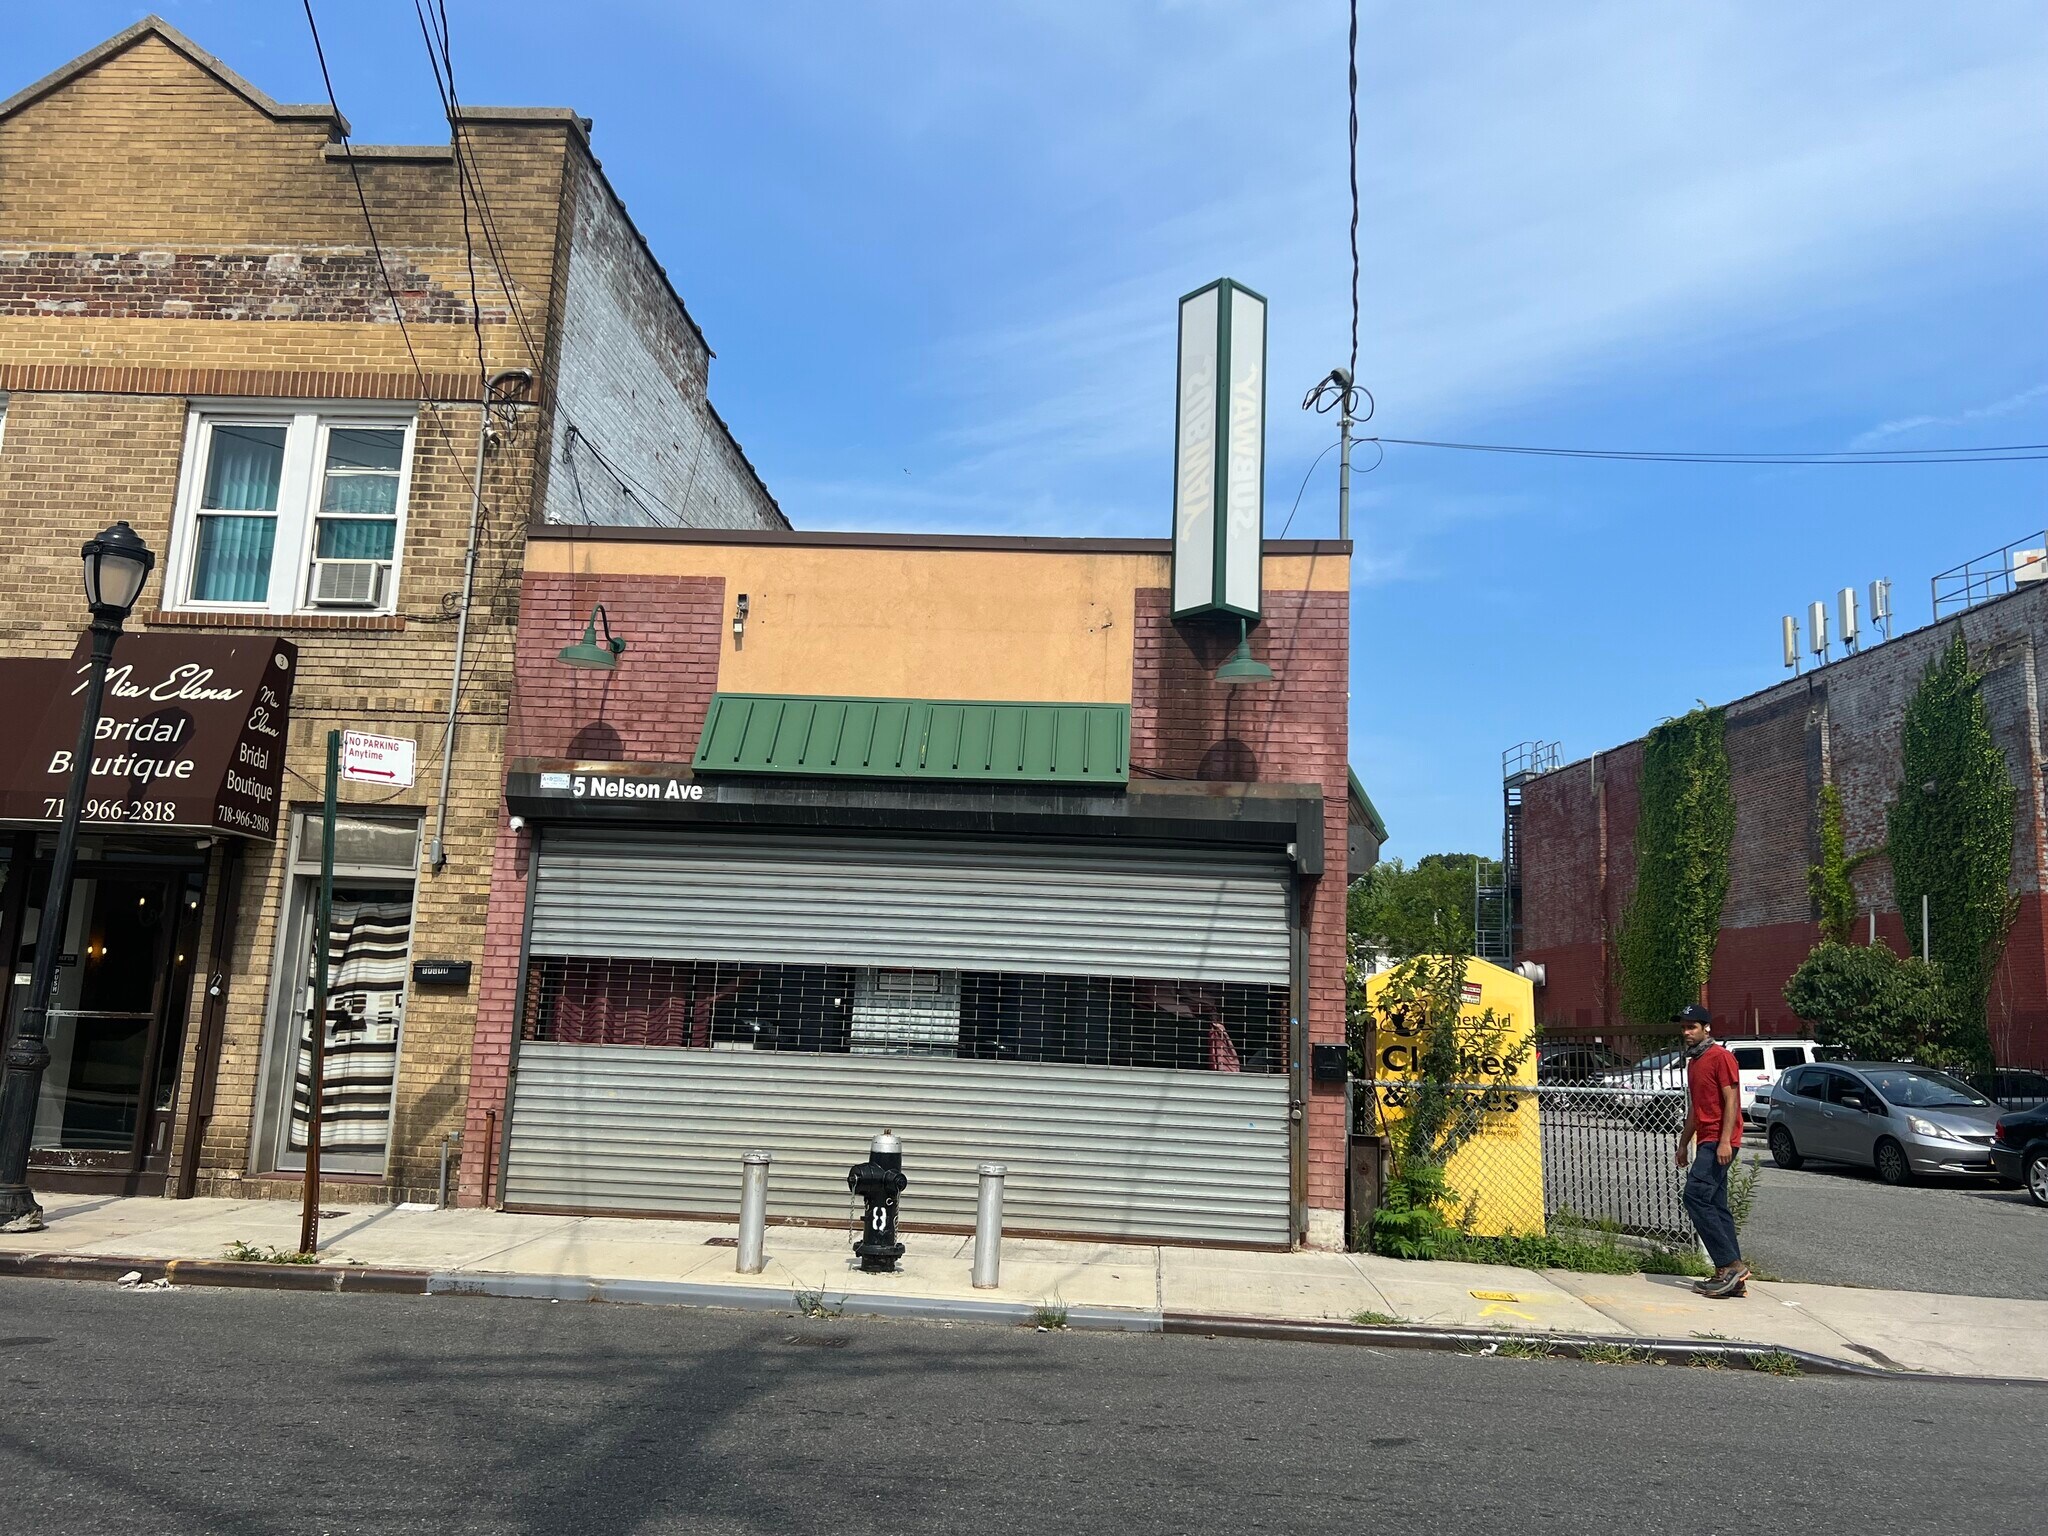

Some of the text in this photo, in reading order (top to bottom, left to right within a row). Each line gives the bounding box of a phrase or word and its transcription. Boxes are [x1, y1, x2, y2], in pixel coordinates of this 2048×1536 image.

[279, 656, 285, 667] 3
[150, 663, 243, 701] Elena
[94, 717, 186, 743] Bridal
[248, 706, 280, 738] Elena
[239, 742, 269, 770] Bridal
[348, 736, 399, 752] NO PARKING
[348, 747, 384, 760] Anytime
[47, 750, 195, 783] Butique
[226, 769, 273, 804] Boutique
[572, 776, 586, 797] 5
[590, 777, 660, 799] Nelson
[664, 779, 703, 800] Ave
[43, 798, 176, 822] 71-966-2818
[218, 804, 270, 833] 718-966-2818
[52, 968, 60, 993] PUSH
[1382, 1045, 1518, 1076] Clhes
